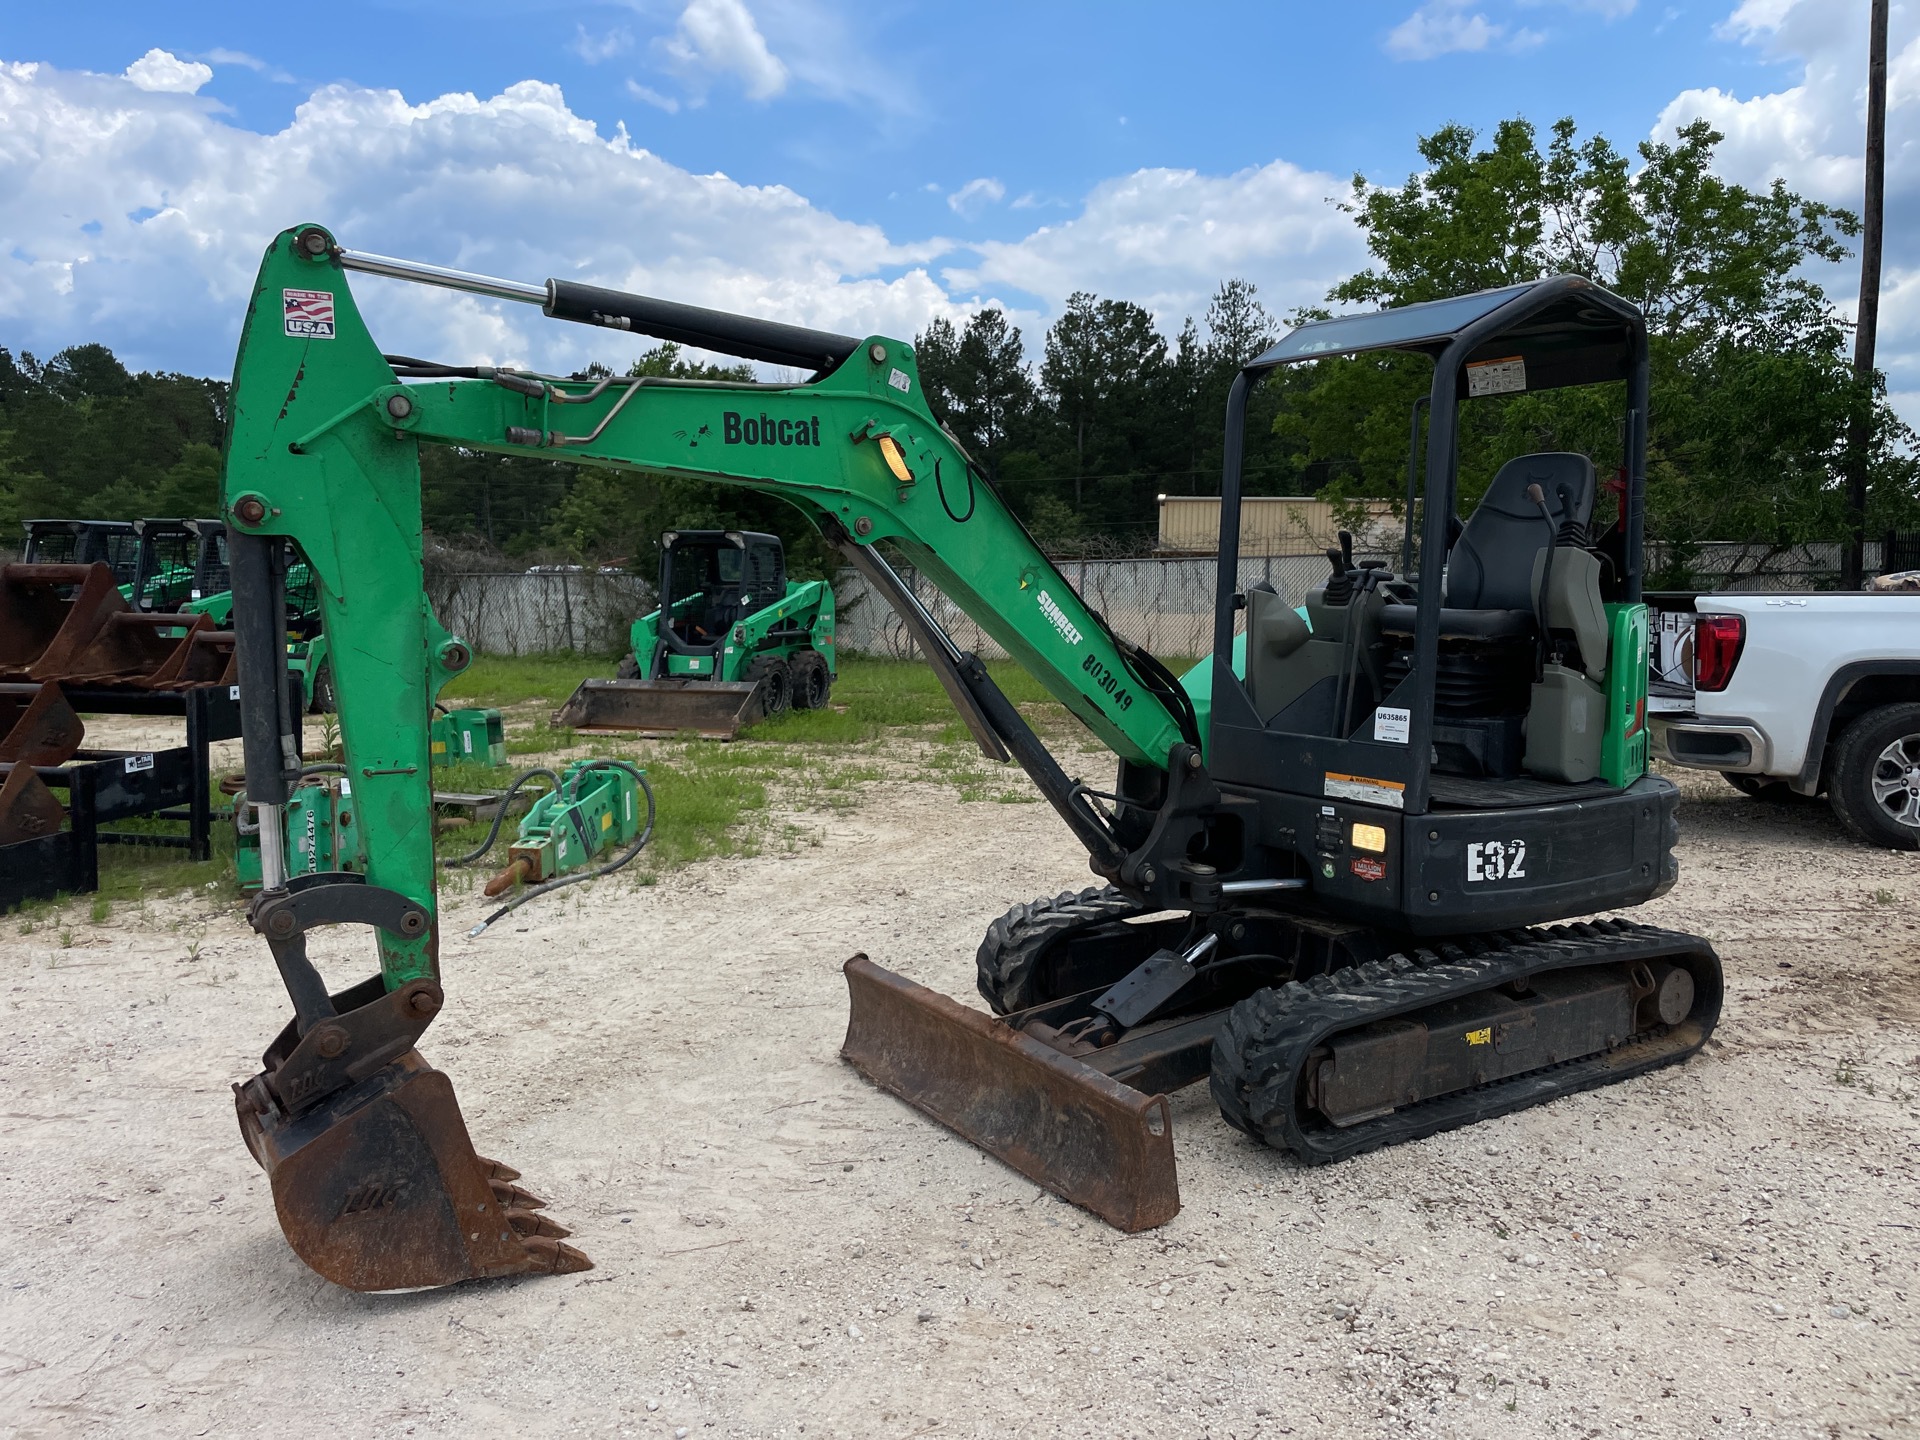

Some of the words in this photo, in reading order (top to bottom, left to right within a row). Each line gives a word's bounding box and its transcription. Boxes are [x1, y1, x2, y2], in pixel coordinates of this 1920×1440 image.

[288, 320, 331, 334] USA
[723, 411, 820, 446] Bobcat
[1037, 590, 1083, 645] SUNBELT
[1039, 605, 1071, 644] RENTALS
[1082, 654, 1133, 711] 803049
[1377, 713, 1408, 722] U635865
[1355, 776, 1379, 785] WARNING
[1358, 862, 1382, 872] MILLION
[1468, 839, 1525, 881] E32
